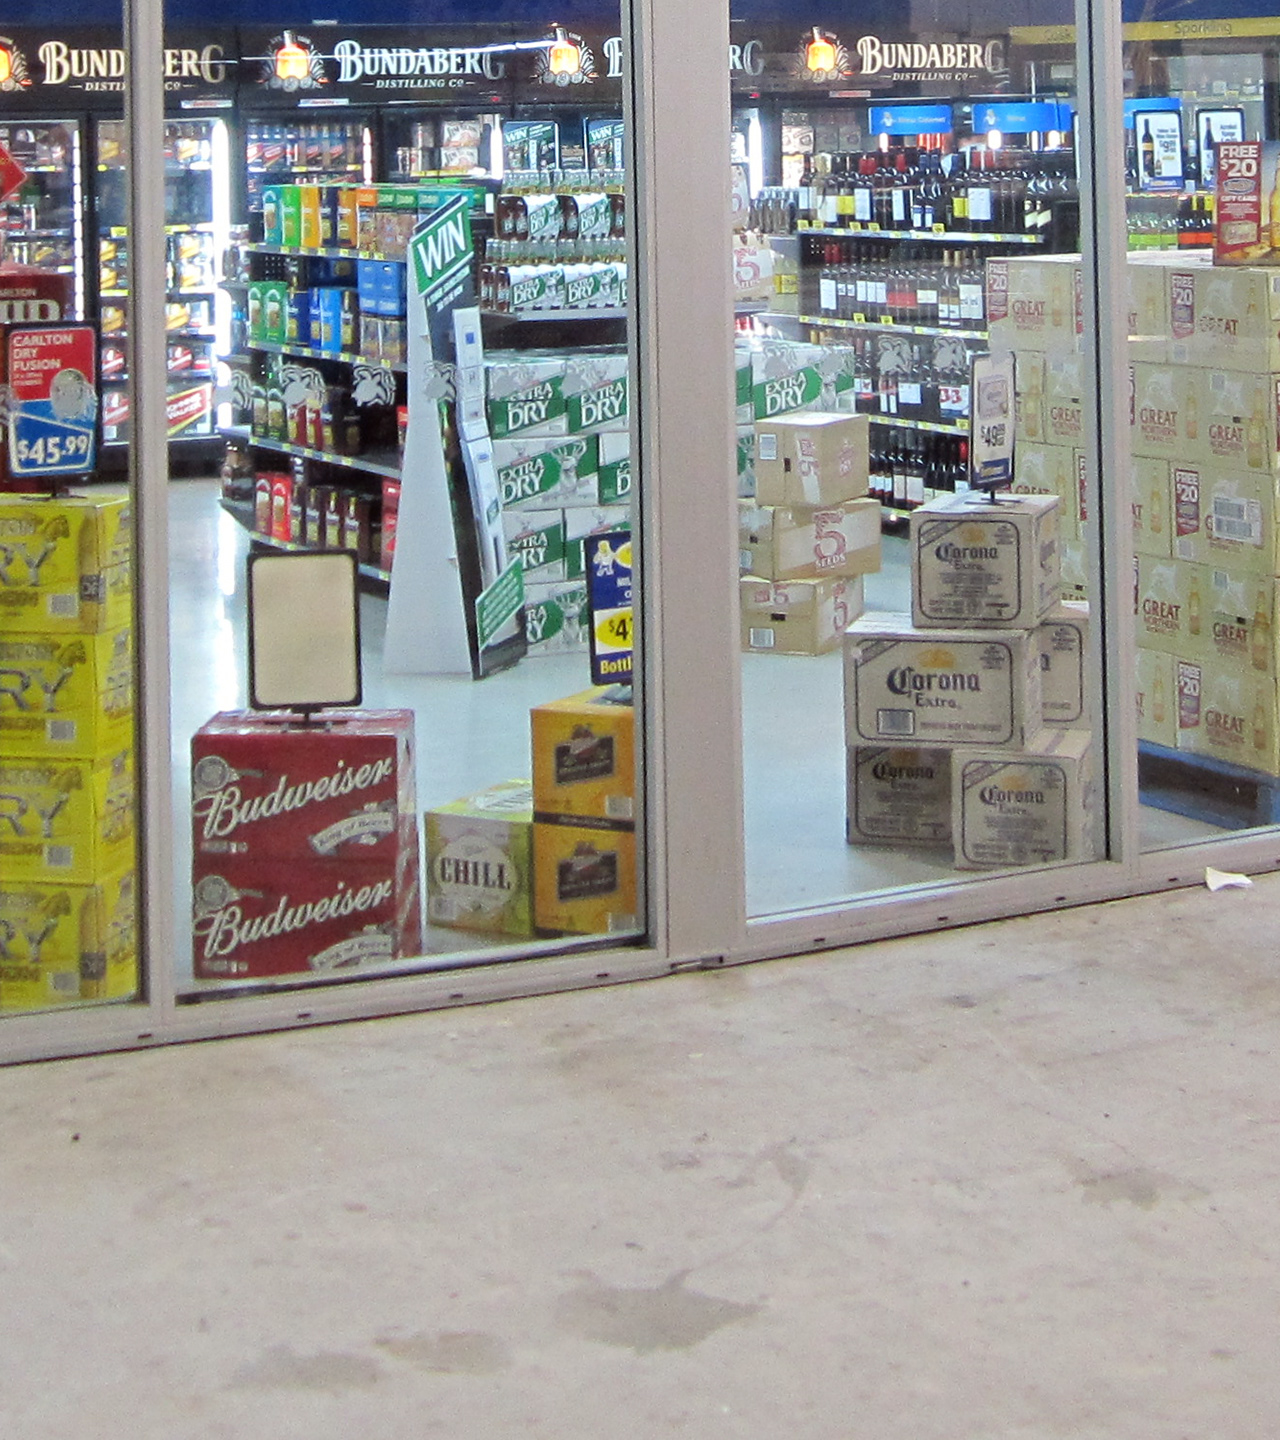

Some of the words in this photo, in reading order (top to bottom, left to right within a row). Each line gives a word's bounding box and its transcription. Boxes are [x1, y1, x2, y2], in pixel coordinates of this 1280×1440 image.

[39, 41, 224, 85] BUNDERG
[334, 40, 506, 83] BUNDABERG
[857, 35, 1008, 75] BUNDABERG
[375, 80, 446, 90] DISTILLING
[892, 73, 952, 81] DISTILLING
[505, 129, 528, 142] WIN
[589, 127, 612, 141] WIN
[1221, 145, 1258, 158] FREE
[1221, 159, 1257, 178] $20
[418, 212, 468, 279] WIN
[1172, 275, 1194, 287] FREE
[513, 284, 540, 303] DRY
[568, 282, 595, 302] DRY
[1172, 289, 1193, 306] $20
[1012, 301, 1046, 316] GREAT
[12, 334, 73, 346] CARLTON
[12, 347, 38, 360] DRY
[13, 358, 61, 371] FUSION
[581, 380, 625, 405] EXTRA
[765, 372, 807, 394] EXTRA
[766, 383, 807, 414] DRY
[508, 399, 550, 431] DRY
[581, 397, 626, 427] DRY
[1050, 407, 1082, 421] GREAT
[1140, 408, 1178, 425] GREAT
[1208, 424, 1244, 442] GREAT
[18, 435, 88, 466] $45.99
[500, 459, 545, 485] EXTRA
[1176, 472, 1198, 485] FREE
[502, 472, 545, 504] DRY
[1176, 486, 1198, 504] $20
[935, 543, 999, 564] Corona
[1143, 599, 1182, 620] GREAT
[1213, 622, 1249, 643] GREAT
[1179, 665, 1200, 679] FREE
[886, 666, 981, 700] Corona
[1179, 679, 1200, 697] $20
[915, 693, 960, 709] Extra
[1205, 710, 1246, 732] GREAT
[872, 763, 935, 781] Corona
[193, 757, 393, 840] Budweiser
[979, 785, 1046, 807] Corona
[439, 857, 511, 889] CHILL
[194, 878, 393, 960] Budweiser
